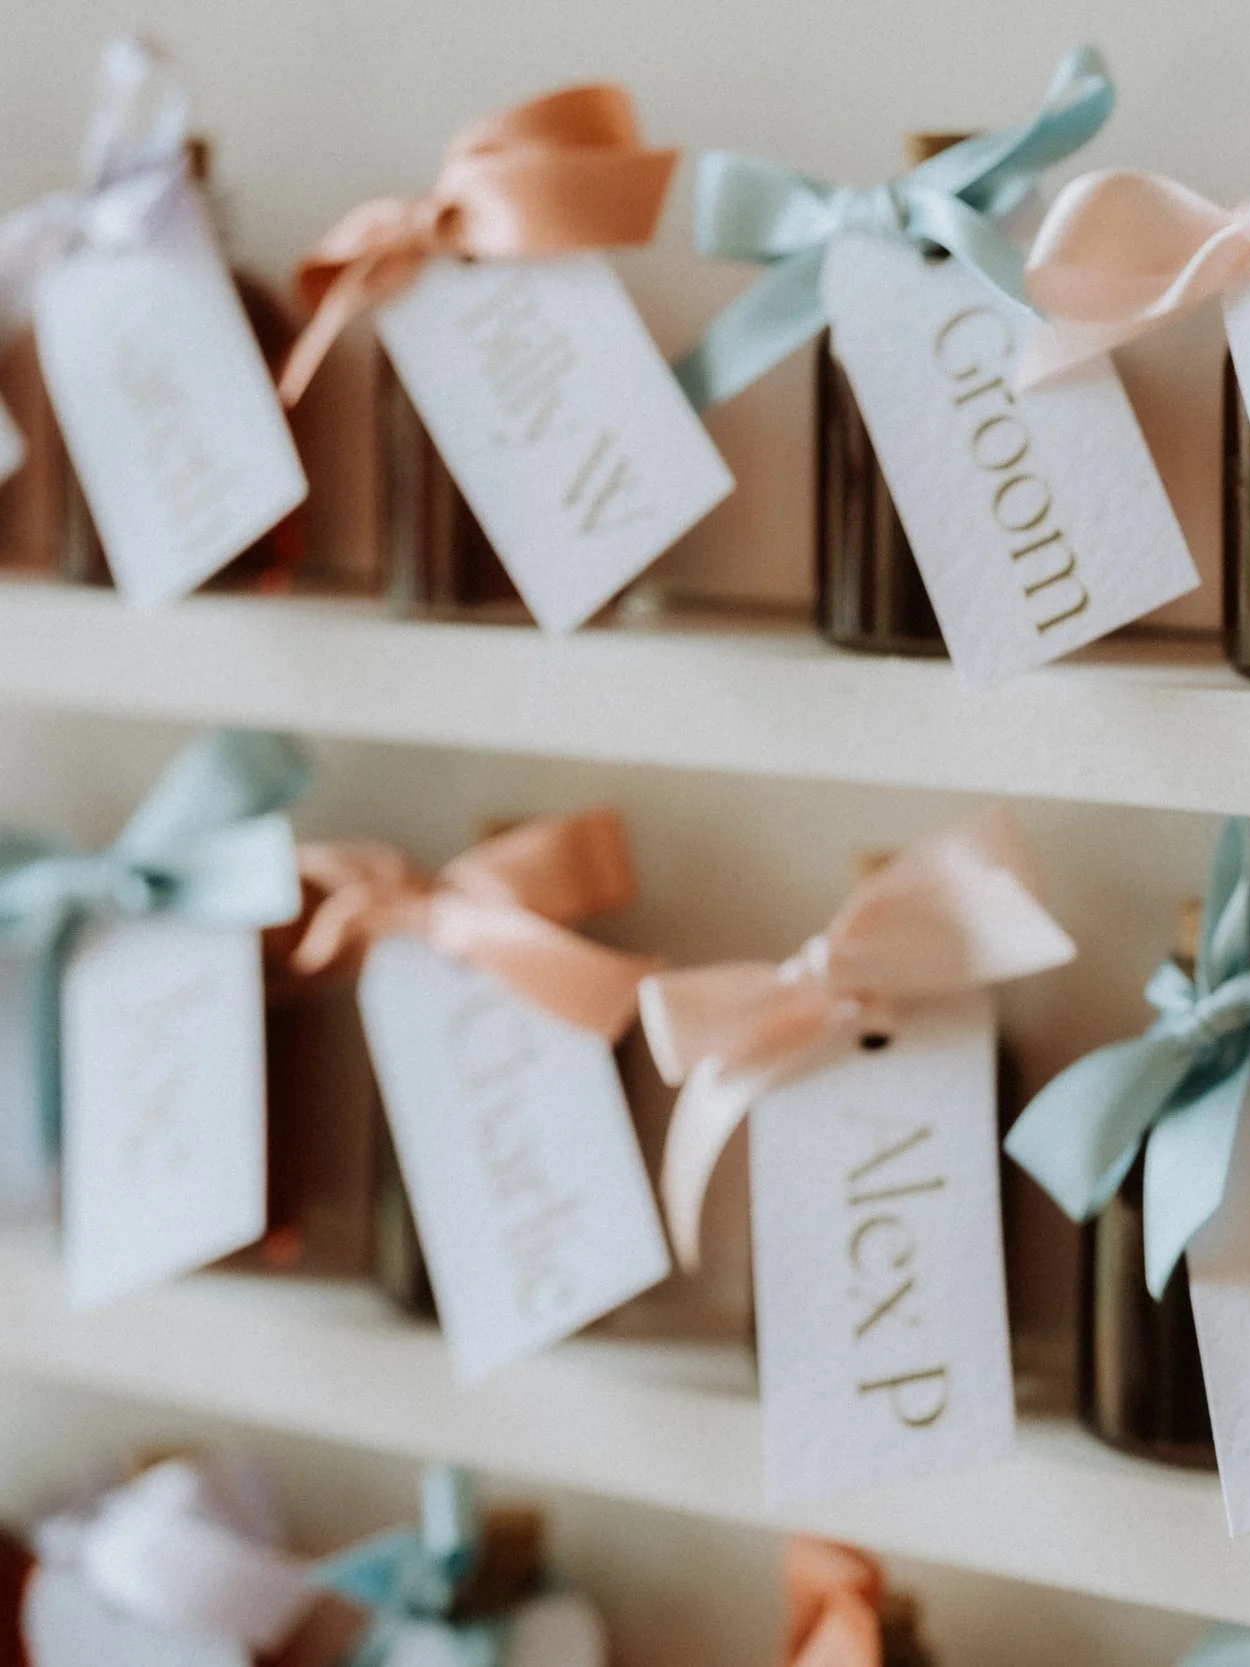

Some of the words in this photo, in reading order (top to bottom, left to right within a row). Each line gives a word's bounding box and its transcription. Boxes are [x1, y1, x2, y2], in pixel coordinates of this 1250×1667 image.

[934, 304, 1091, 635] Groom
[842, 1106, 947, 1338] Alex
[857, 1365, 951, 1429] P
